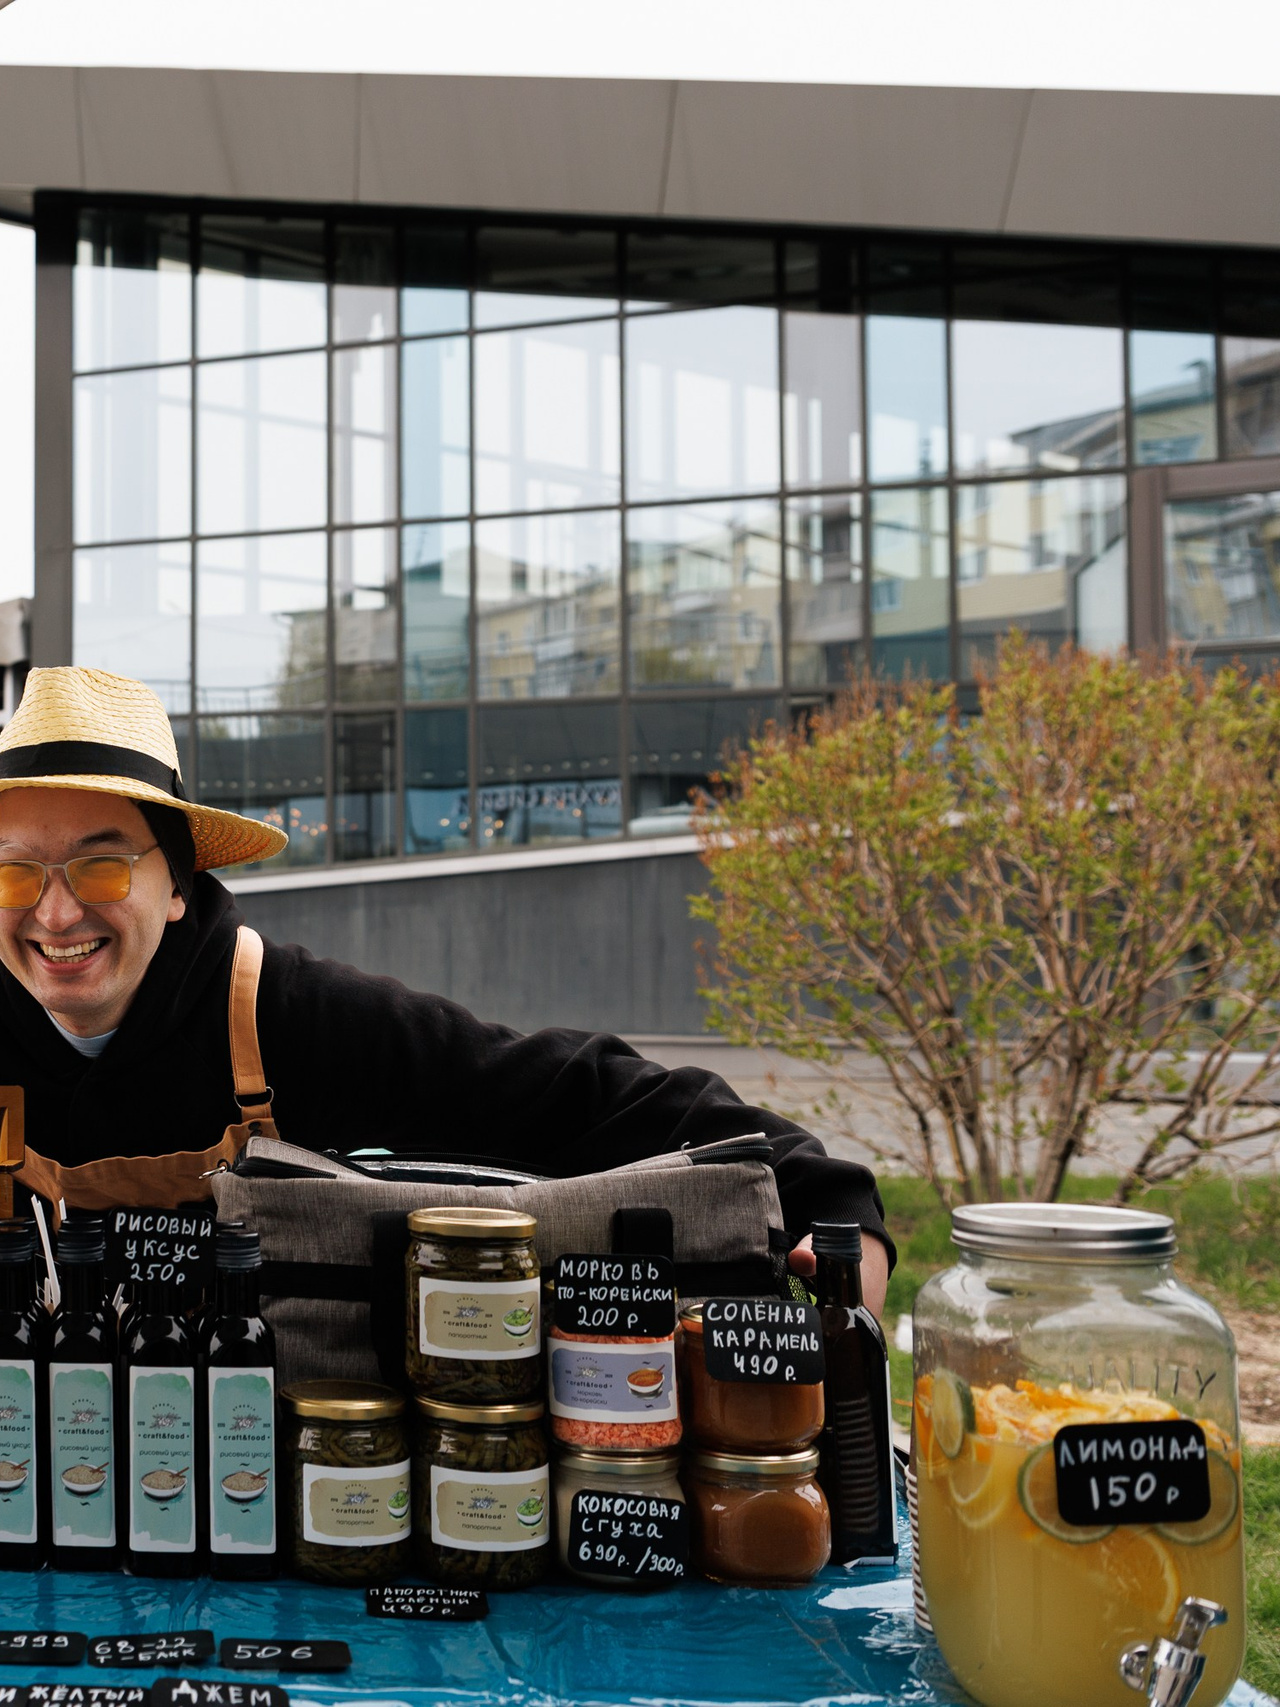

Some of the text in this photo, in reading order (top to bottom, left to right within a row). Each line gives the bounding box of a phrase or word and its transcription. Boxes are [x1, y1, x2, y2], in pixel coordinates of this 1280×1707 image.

[114, 1212, 212, 1237] РИСОВЫЙ
[125, 1239, 200, 1263] УКСУС
[559, 1259, 659, 1281] МОРКОВЬ
[577, 1305, 619, 1327] 200
[706, 1300, 806, 1324] СОЛЁНАЯ
[447, 1320, 488, 1329] craft&food
[712, 1327, 820, 1352] КАРАМЕЛЬ
[733, 1352, 779, 1375] 490
[569, 1381, 608, 1389] craft&food
[142, 1432, 185, 1440] craft&food
[1059, 1434, 1205, 1468] ЛИМОНАД
[1089, 1471, 1157, 1512] 150
[461, 1511, 502, 1520] craft&food
[578, 1495, 680, 1520] КОКОСОВАЯ
[581, 1517, 663, 1538] СГУХА
[369, 1587, 480, 1599] ПАПОРОТНИК
[381, 1604, 434, 1614] 490
[28, 1684, 145, 1702] ЖЁЛТЫЙ
[171, 1679, 272, 1707] ДЖЕМ
